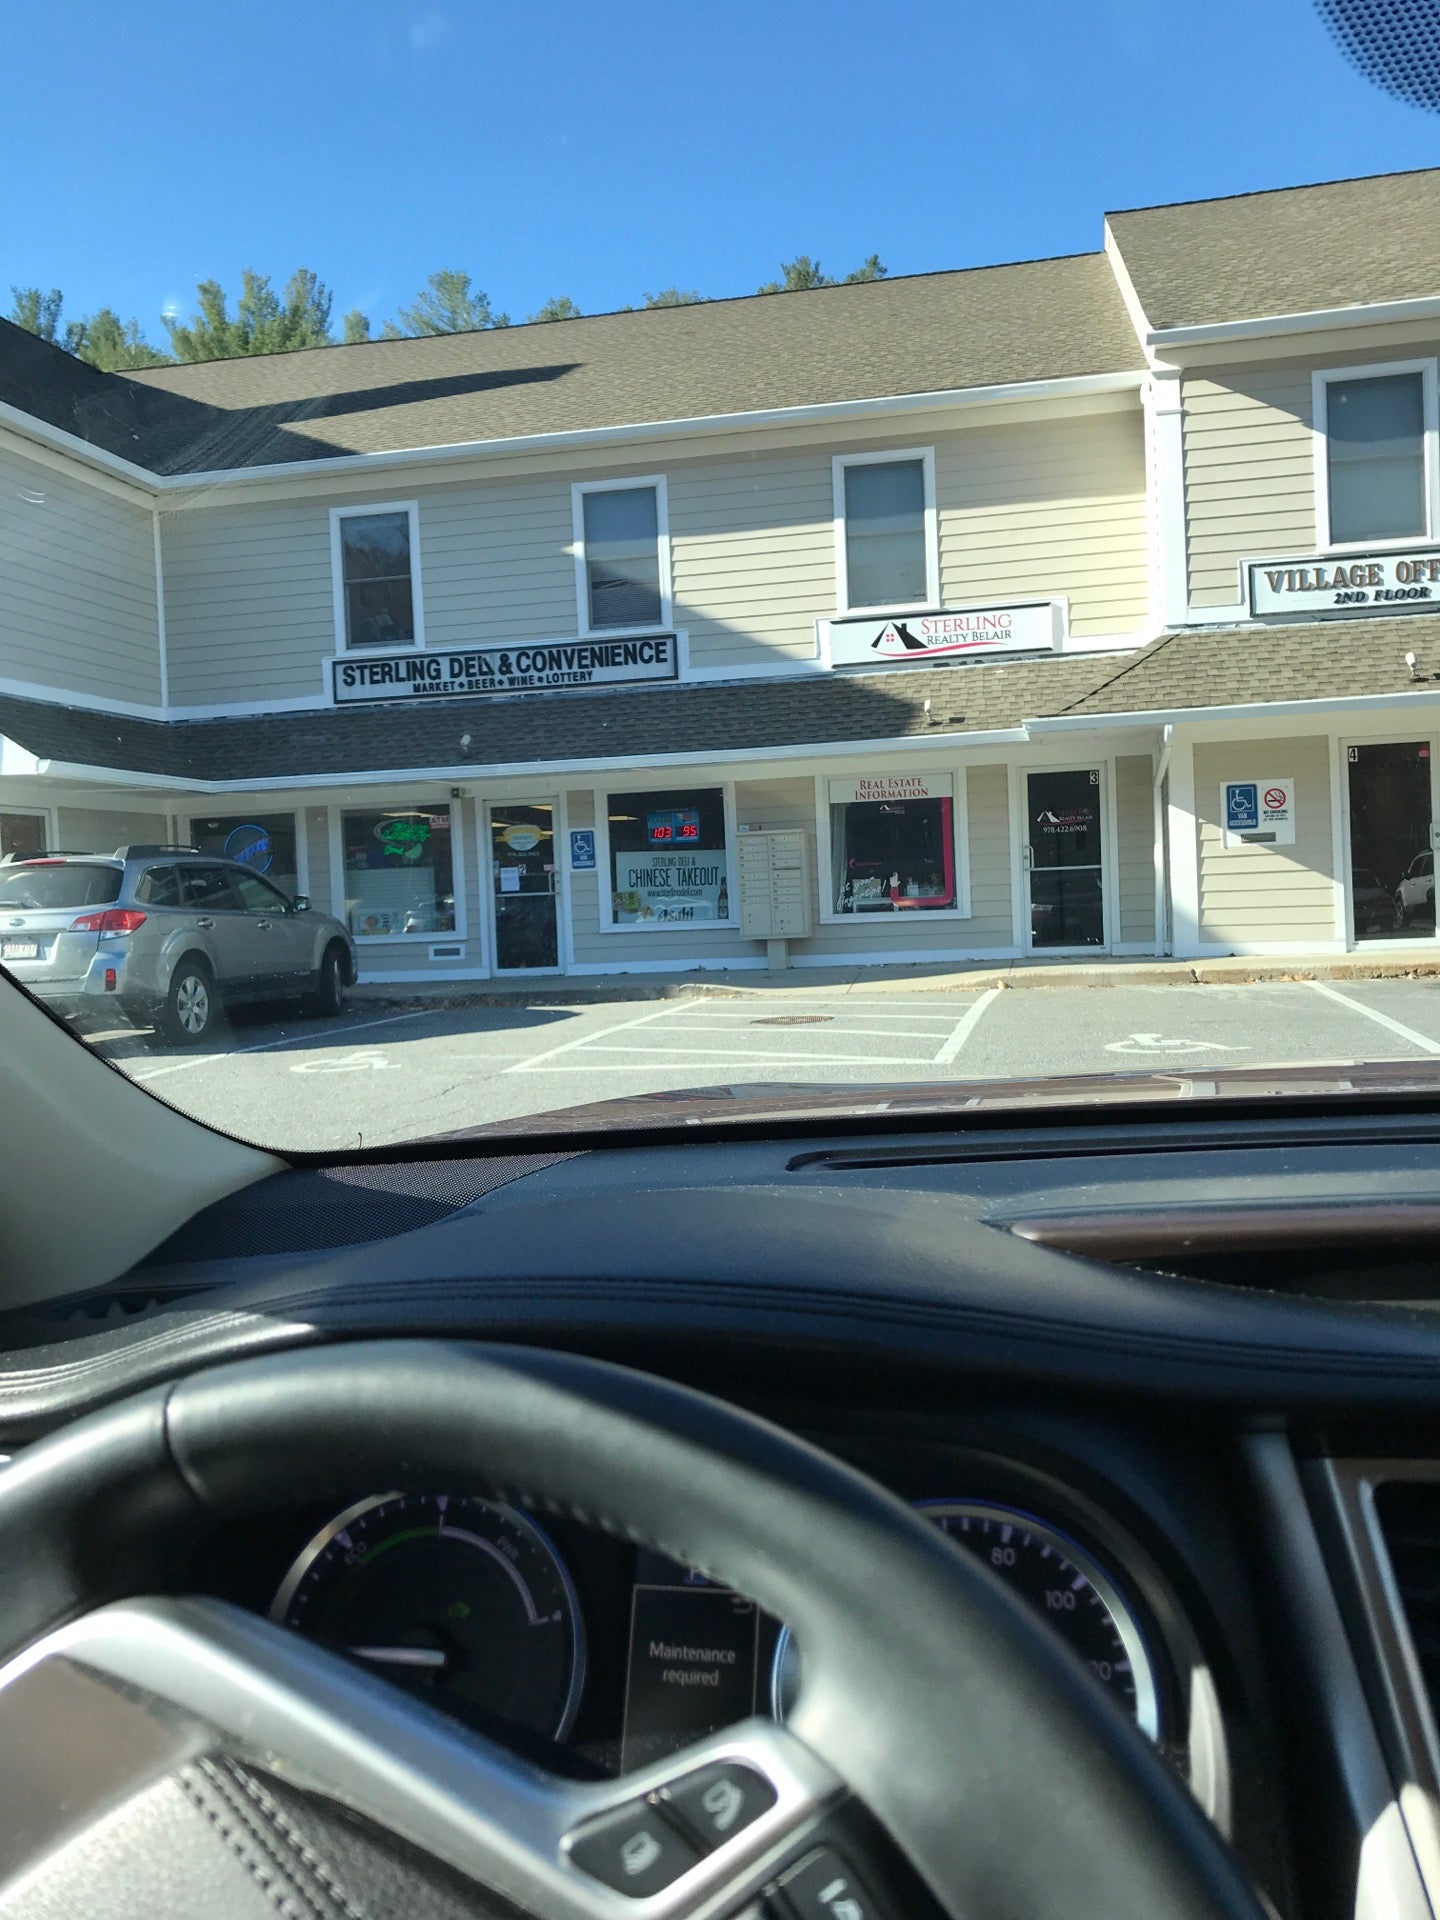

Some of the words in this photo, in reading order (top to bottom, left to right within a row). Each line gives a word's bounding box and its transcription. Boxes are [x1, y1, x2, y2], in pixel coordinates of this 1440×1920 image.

[1264, 564, 1384, 593] VILLAGE
[1334, 591, 1369, 605] 2ND
[1374, 586, 1432, 602] FLOOR
[921, 613, 1012, 635] STERLING
[927, 632, 968, 646] REALTY
[972, 629, 1012, 642] BELAIR
[343, 657, 441, 687] STERLING
[498, 653, 513, 676] &
[515, 641, 668, 674] CONVENIENCE
[413, 681, 455, 693] MARKET
[467, 677, 496, 690] BEER
[508, 675, 535, 687] WINE
[546, 670, 593, 683] LOTTERY
[1350, 749, 1358, 760] 4
[859, 779, 885, 790] REAL
[888, 777, 923, 788] ESTATE
[1091, 773, 1098, 783] 3
[855, 788, 929, 800] INFORMATION
[654, 827, 672, 838] 103
[683, 825, 697, 836] 95
[519, 865, 526, 874] 2
[652, 857, 676, 867] STERLING
[628, 868, 672, 888] CHINESE
[676, 866, 719, 887] TAKEOUT
[991, 1547, 1016, 1566] 80
[1046, 1590, 1076, 1610] 100
[650, 1640, 736, 1664] Maintenance
[662, 1669, 720, 1687] required
